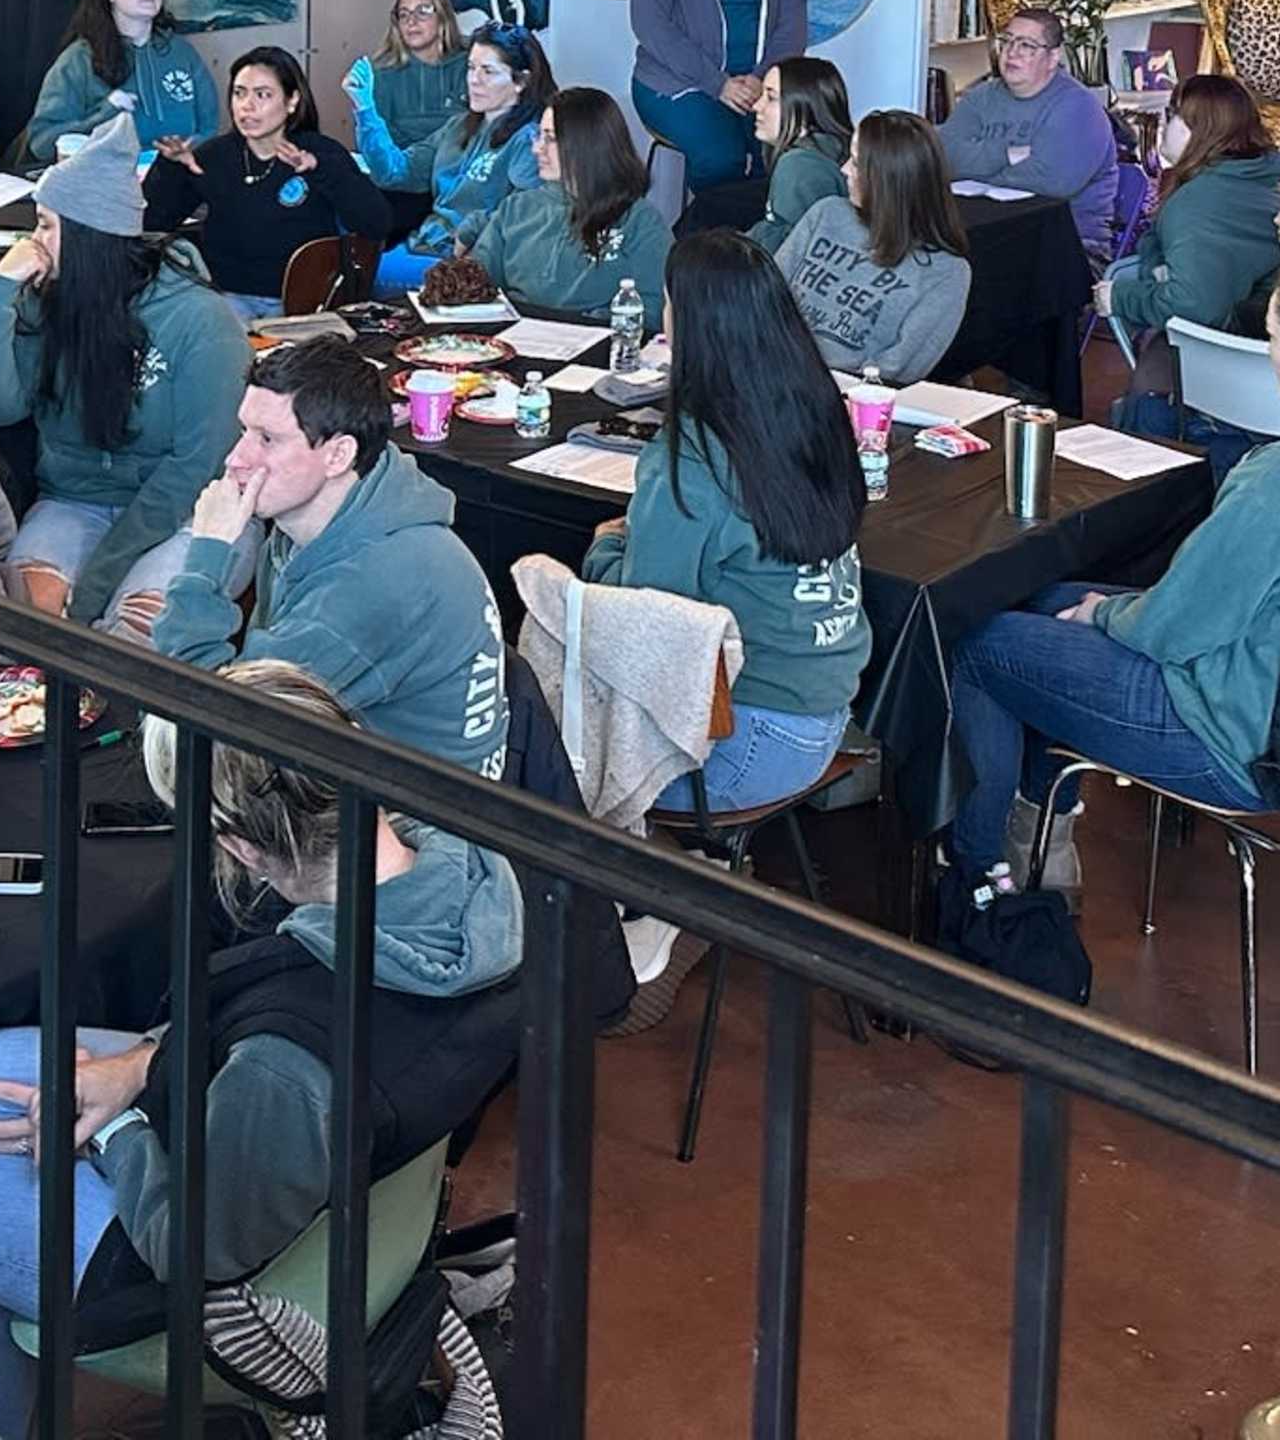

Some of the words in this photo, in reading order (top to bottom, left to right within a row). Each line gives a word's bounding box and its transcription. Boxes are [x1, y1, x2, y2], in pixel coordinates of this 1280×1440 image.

[800, 258, 840, 297] THE
[836, 285, 883, 326] SEA
[809, 237, 870, 272] CITY
[870, 269, 910, 295] BY
[463, 651, 498, 740] CITY
